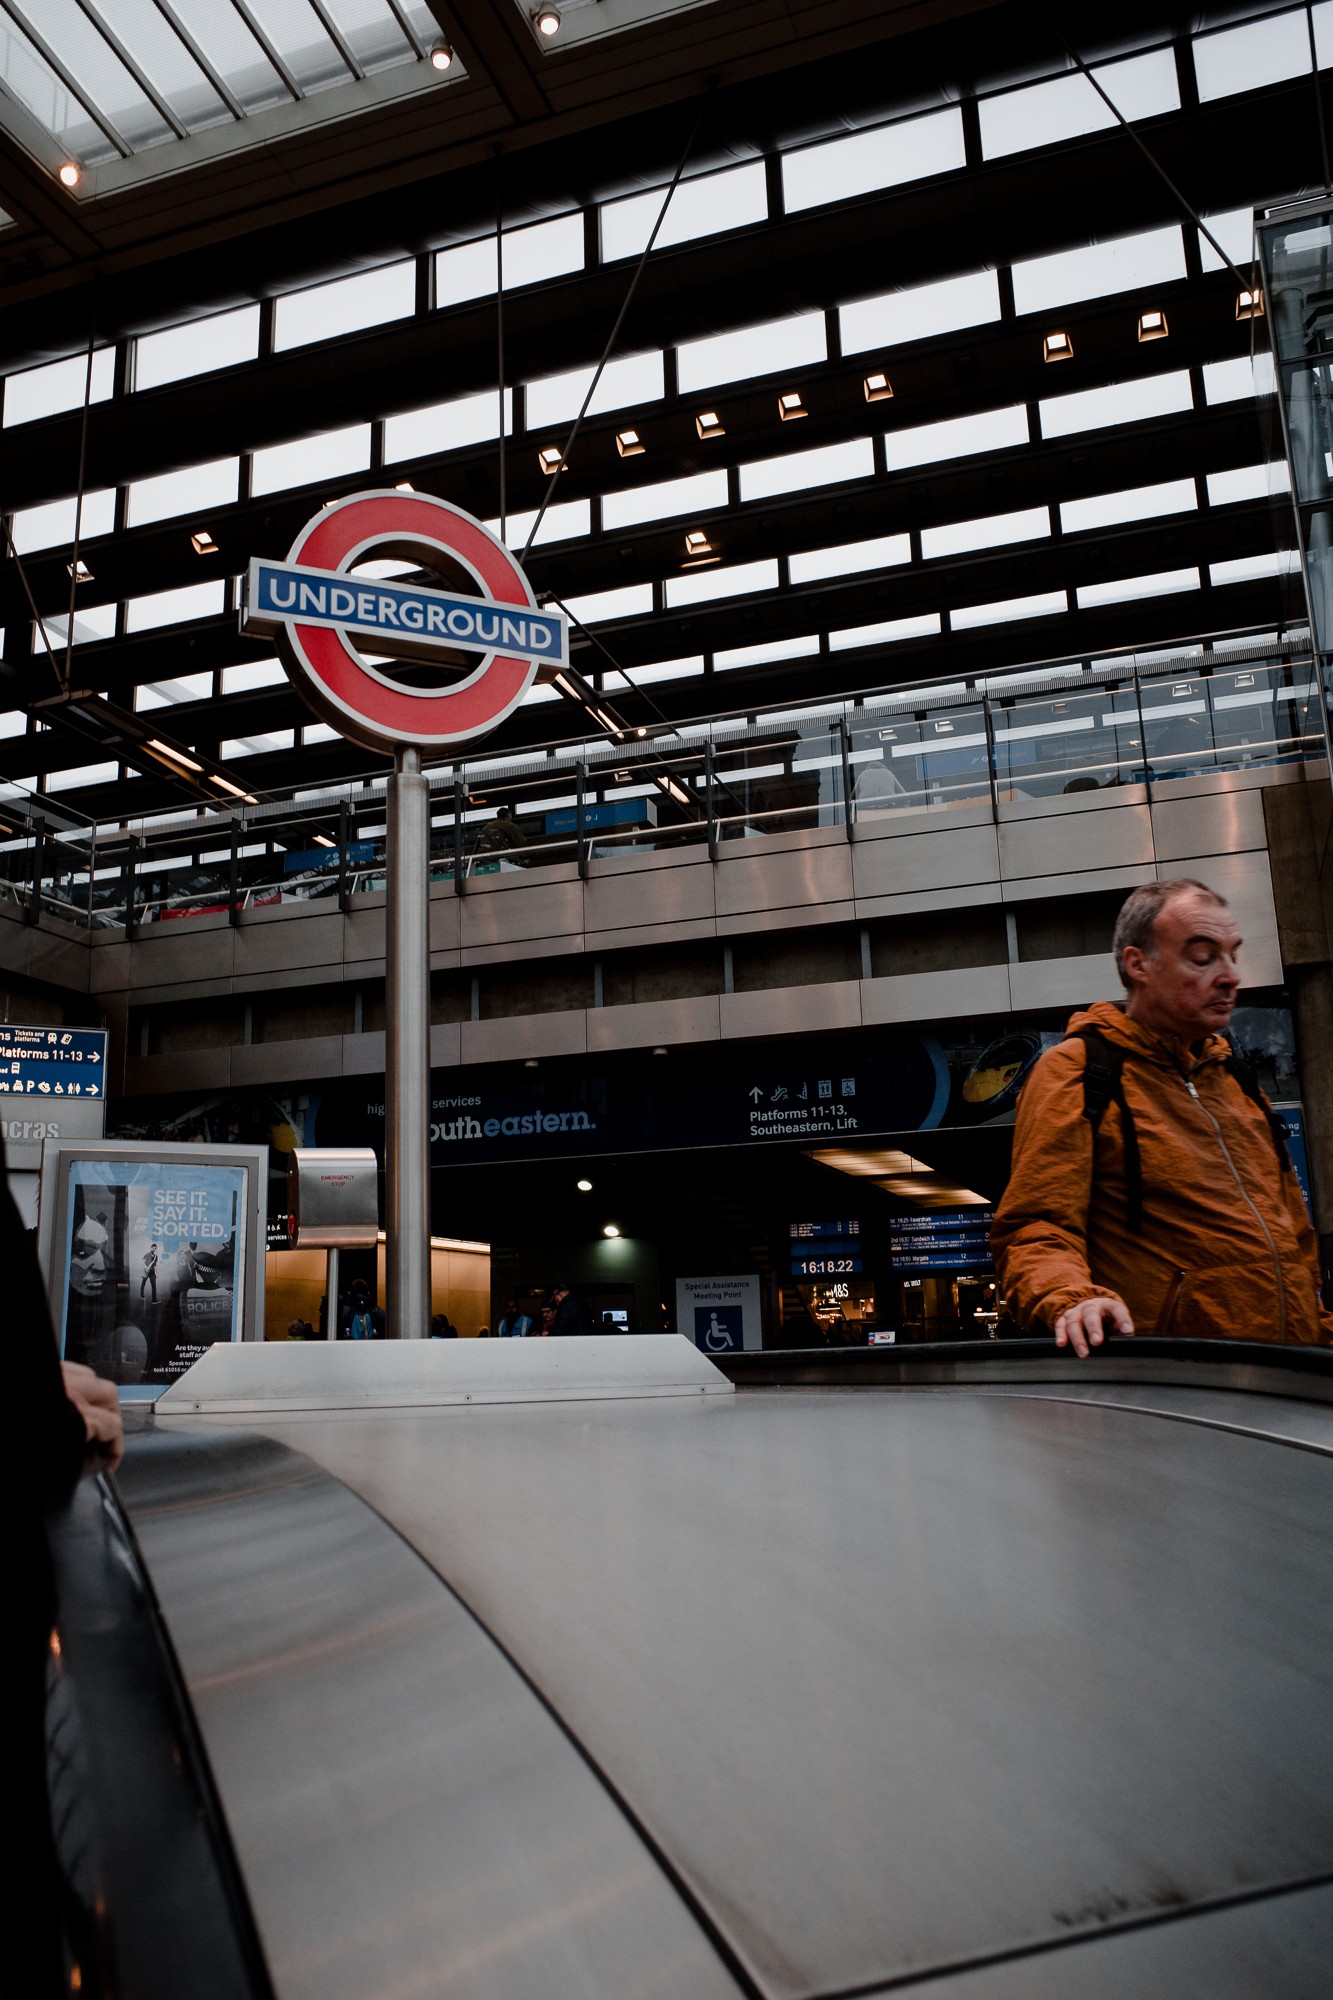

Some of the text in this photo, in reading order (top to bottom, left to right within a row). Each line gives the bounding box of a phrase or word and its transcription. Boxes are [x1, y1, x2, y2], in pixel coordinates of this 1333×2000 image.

[269, 578, 552, 650] UNDERGROUND
[52, 1049, 83, 1061] 11-13
[367, 1096, 482, 1117] hig services
[750, 1104, 848, 1122] Platforms 11-13,
[430, 1110, 597, 1142] outheastern.
[750, 1117, 858, 1136] Southeastern, Lift
[154, 1189, 209, 1206] SEE IT.
[153, 1205, 208, 1222] SAY IT.
[152, 1221, 228, 1239] SORTED.
[801, 1259, 854, 1274] 16:18.22
[685, 1281, 750, 1291] Special Assistance
[693, 1290, 742, 1300] Meeting Point
[187, 1300, 230, 1313] POLICE
[187, 1344, 202, 1352] they
